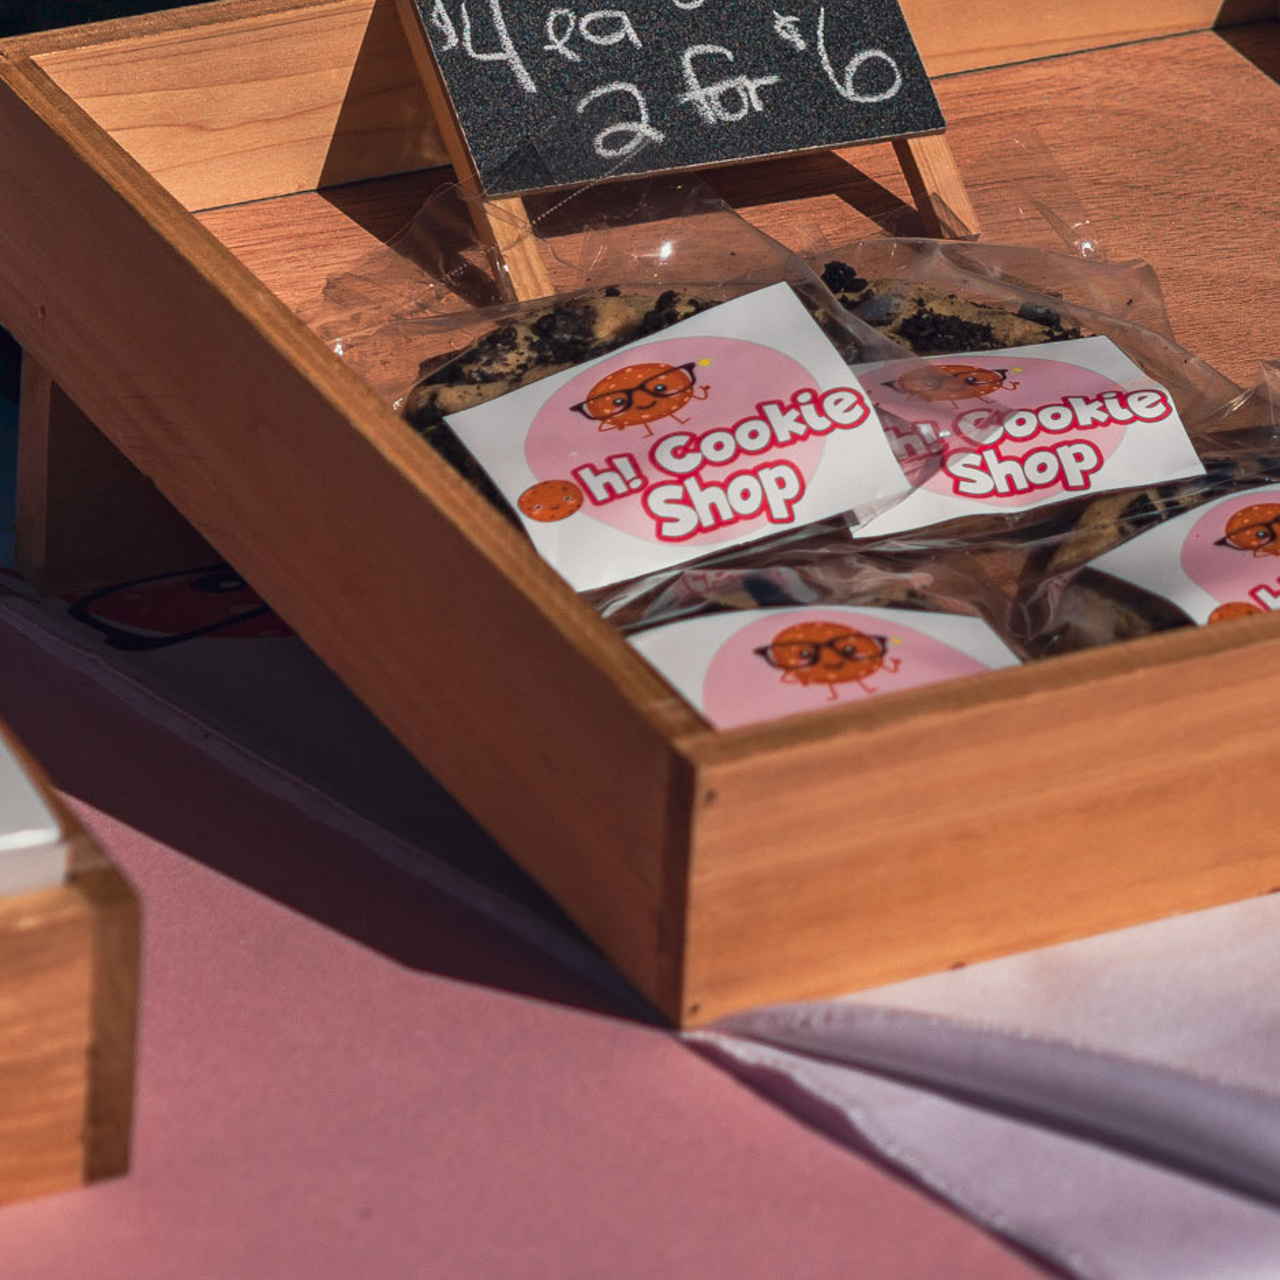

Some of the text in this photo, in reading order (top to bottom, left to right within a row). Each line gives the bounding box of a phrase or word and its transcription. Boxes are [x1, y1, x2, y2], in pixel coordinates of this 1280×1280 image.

[544, 8, 643, 62] ea
[577, 7, 902, 158] 2 for $6
[649, 387, 871, 477] Cookie
[955, 389, 1174, 447] Cookie
[642, 460, 806, 542] Shop
[942, 439, 1104, 498] Shop
